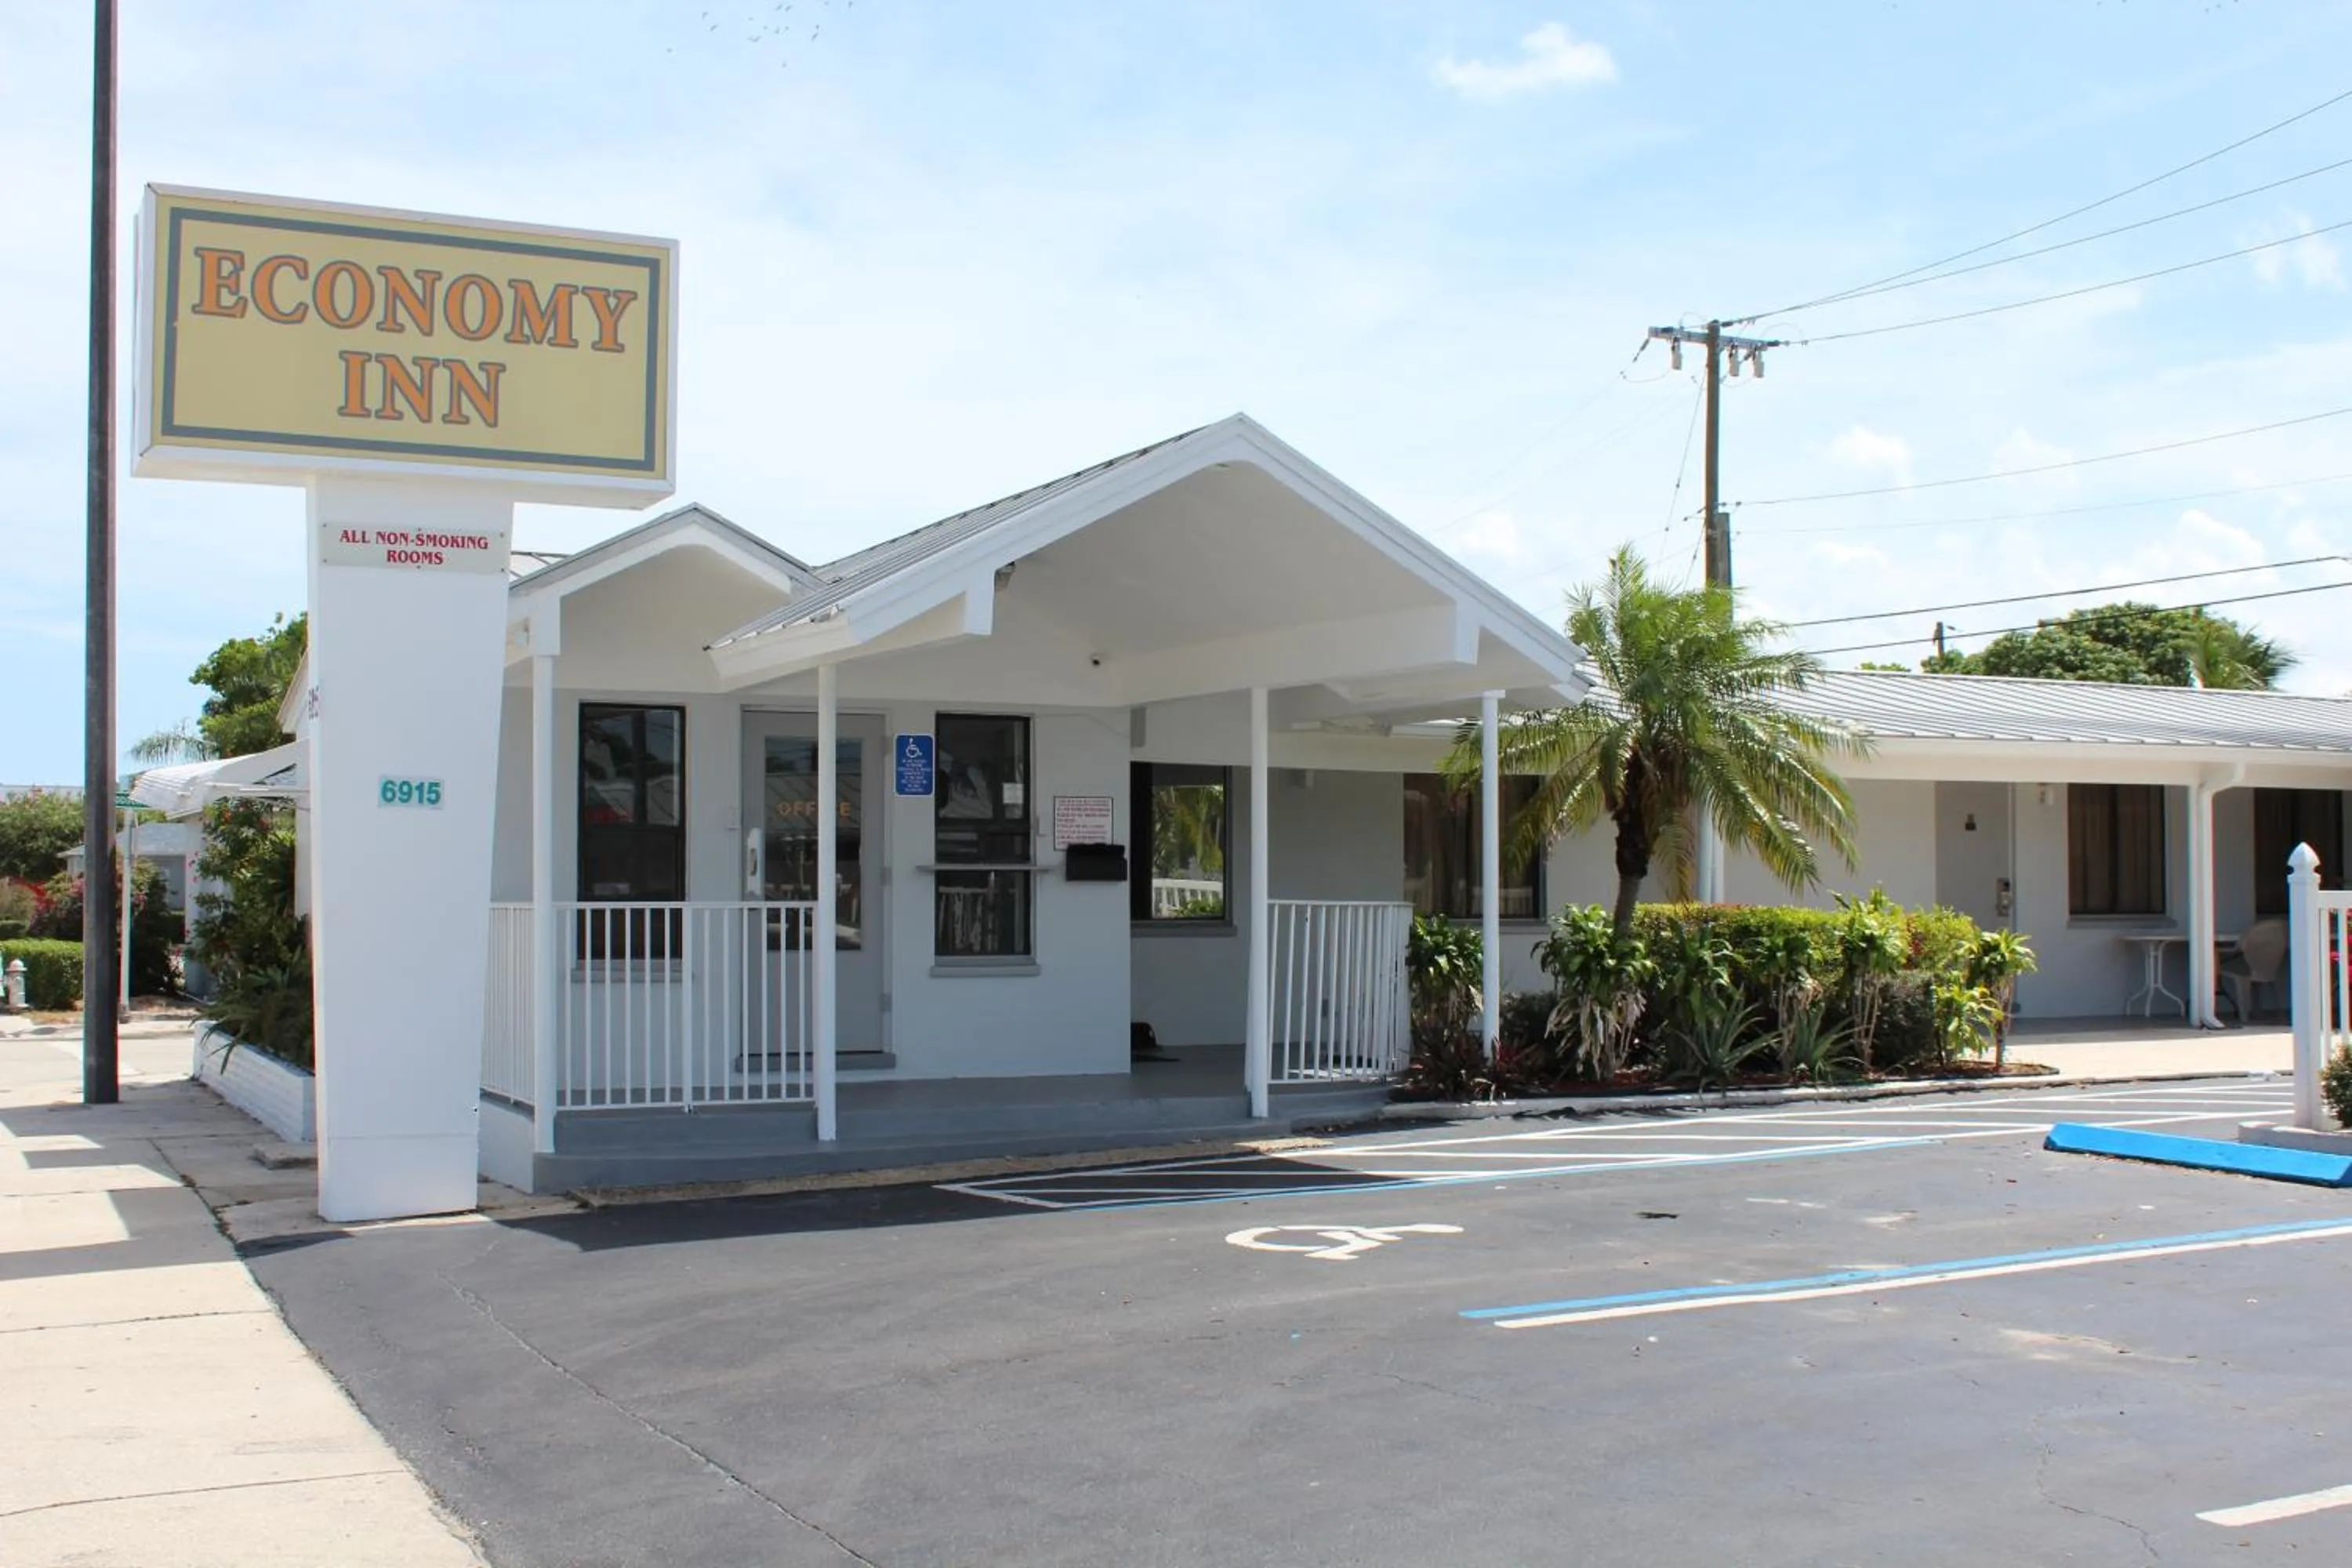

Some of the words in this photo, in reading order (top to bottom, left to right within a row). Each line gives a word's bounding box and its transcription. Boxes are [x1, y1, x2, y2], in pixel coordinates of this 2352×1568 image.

[191, 246, 638, 353] ECONOMY
[337, 350, 506, 428] INN
[339, 529, 370, 543] ALL
[376, 531, 489, 550] NON-SMOKING
[387, 550, 444, 565] ROOMS
[382, 779, 441, 805] 6915
[776, 800, 851, 817] OFFE
